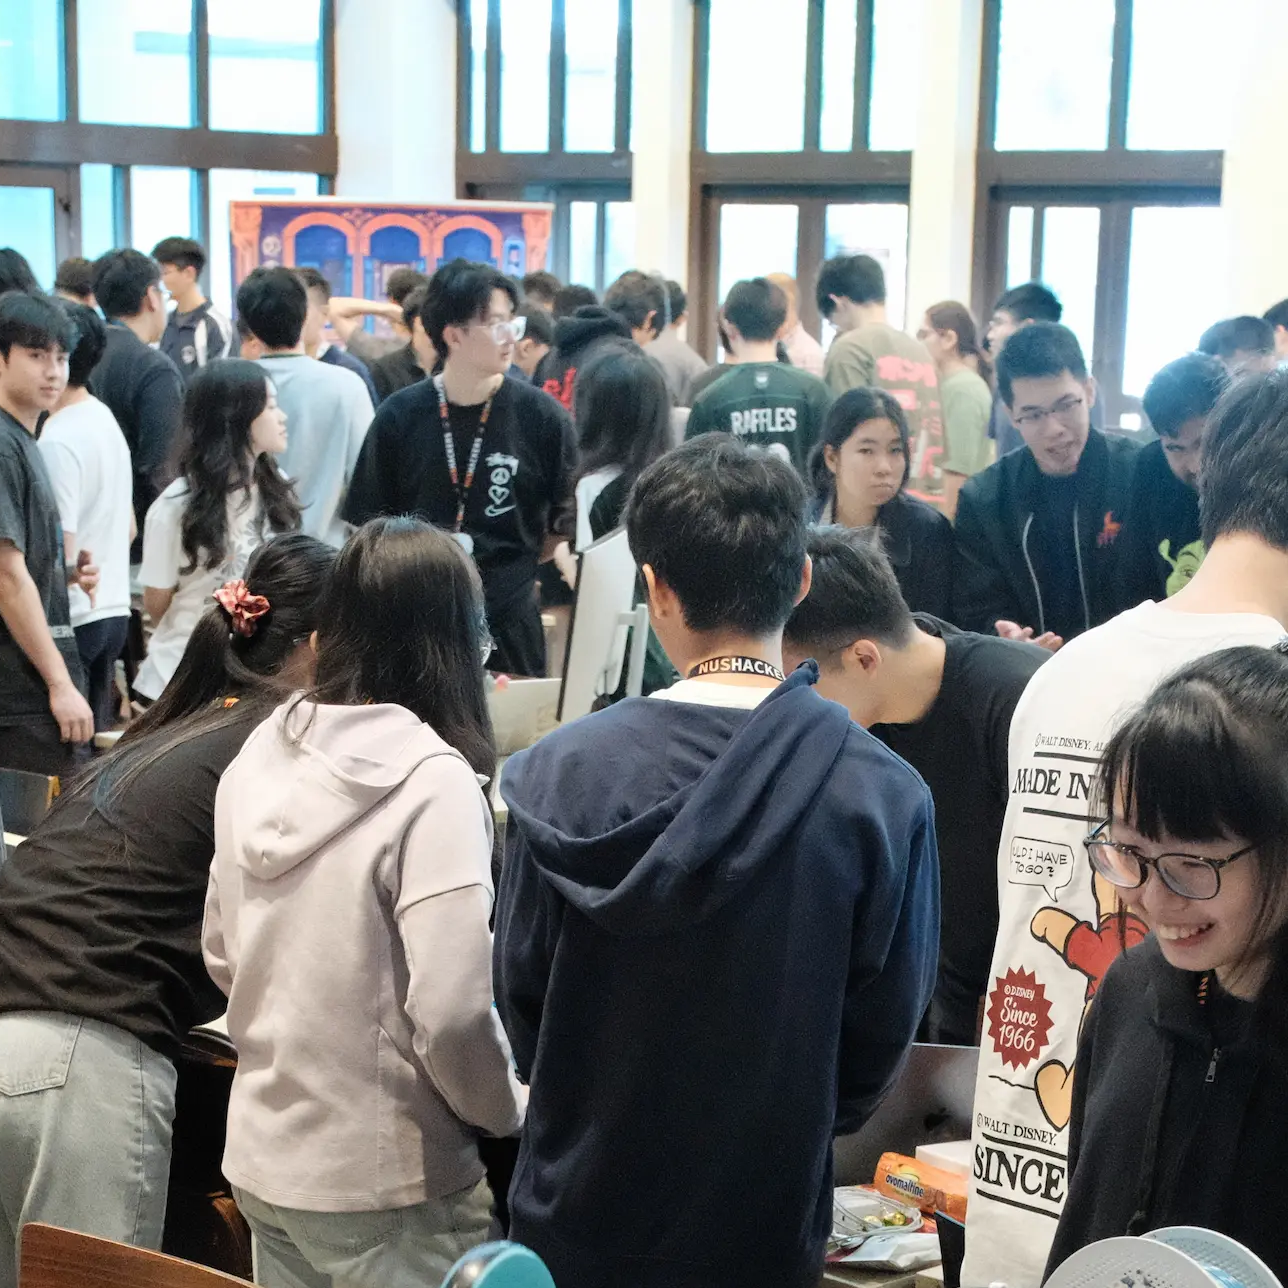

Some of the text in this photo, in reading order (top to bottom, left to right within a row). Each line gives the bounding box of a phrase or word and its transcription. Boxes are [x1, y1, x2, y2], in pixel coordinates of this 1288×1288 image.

[730, 407, 797, 435] RAFFLES
[1012, 767, 1062, 796] MADE
[1035, 849, 1068, 866] HAVE
[999, 996, 1039, 1028] Since
[998, 1023, 1036, 1052] 1966
[885, 1173, 925, 1198] ovomaltine
[972, 1143, 1066, 1204] SINCE
